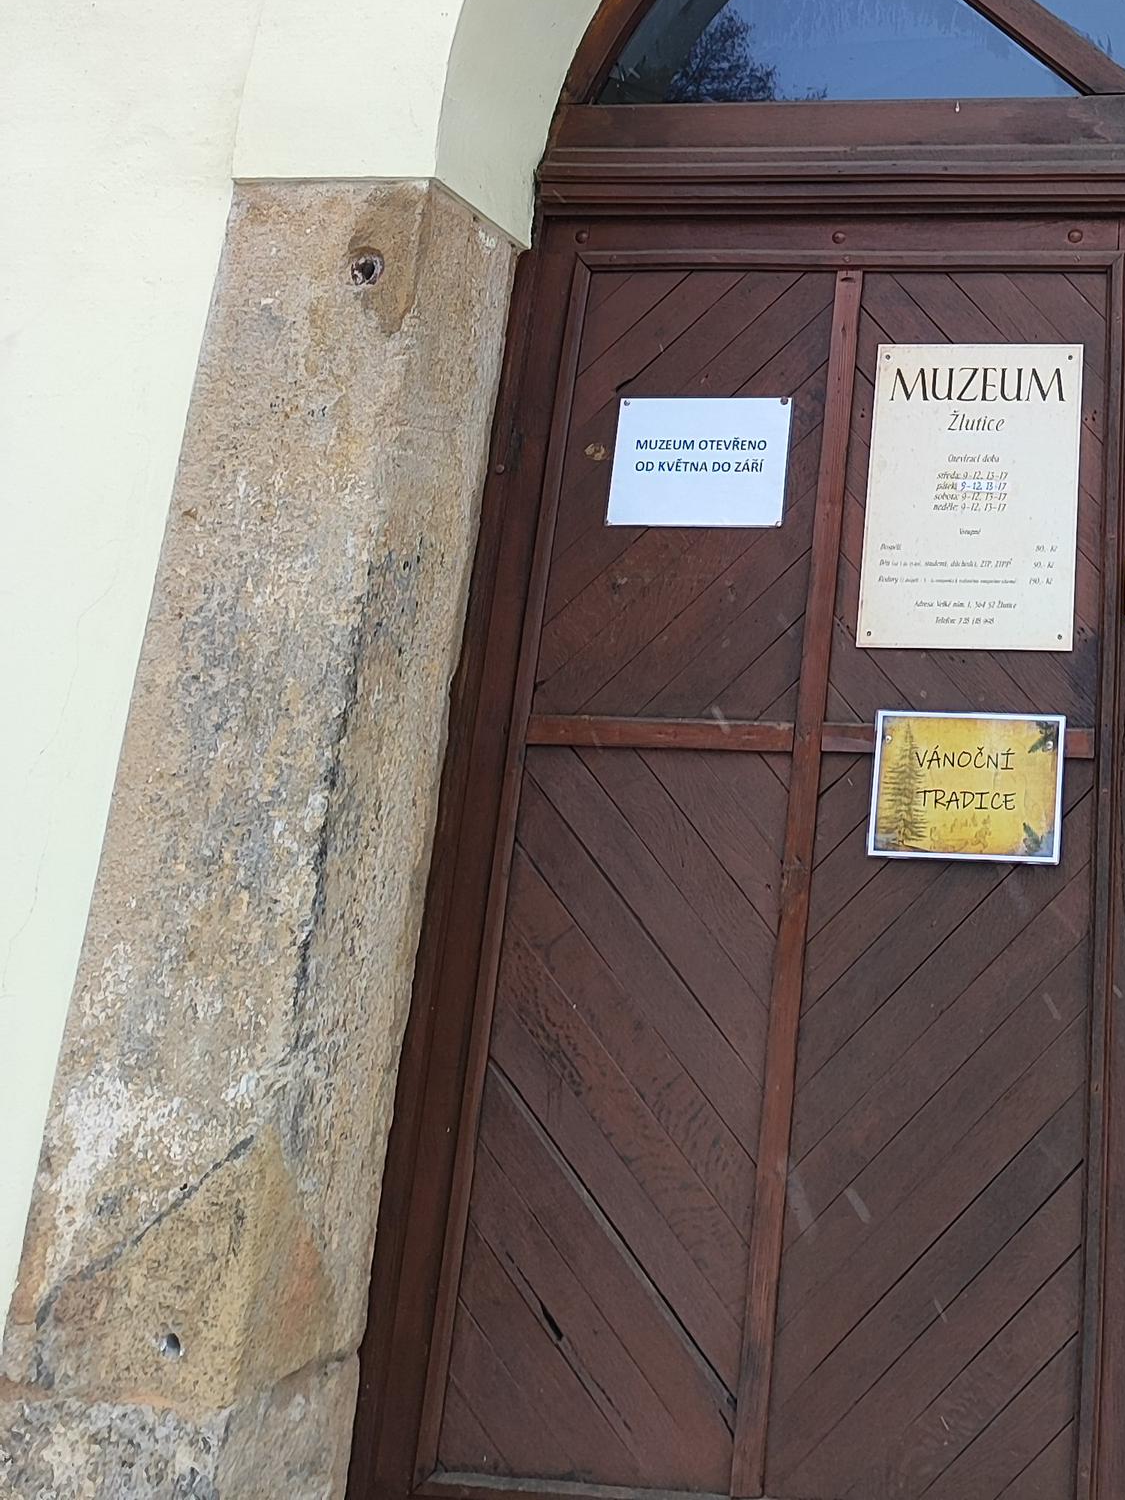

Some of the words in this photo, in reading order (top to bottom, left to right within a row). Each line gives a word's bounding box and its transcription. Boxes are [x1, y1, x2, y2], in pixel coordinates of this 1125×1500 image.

[890, 367, 1066, 402] MUZEUM
[947, 410, 1004, 432] Žlutice
[635, 439, 695, 451] MUZEUM
[698, 436, 767, 451] OTEVŘENO
[635, 460, 655, 472] OD
[658, 458, 708, 472] KVĚTNA
[711, 461, 731, 473] DO
[734, 458, 764, 473] ZÁŘÍ
[982, 454, 1000, 463] doba
[915, 745, 1016, 771] VÁNOČNÍ
[917, 790, 1016, 810] TRADICE
